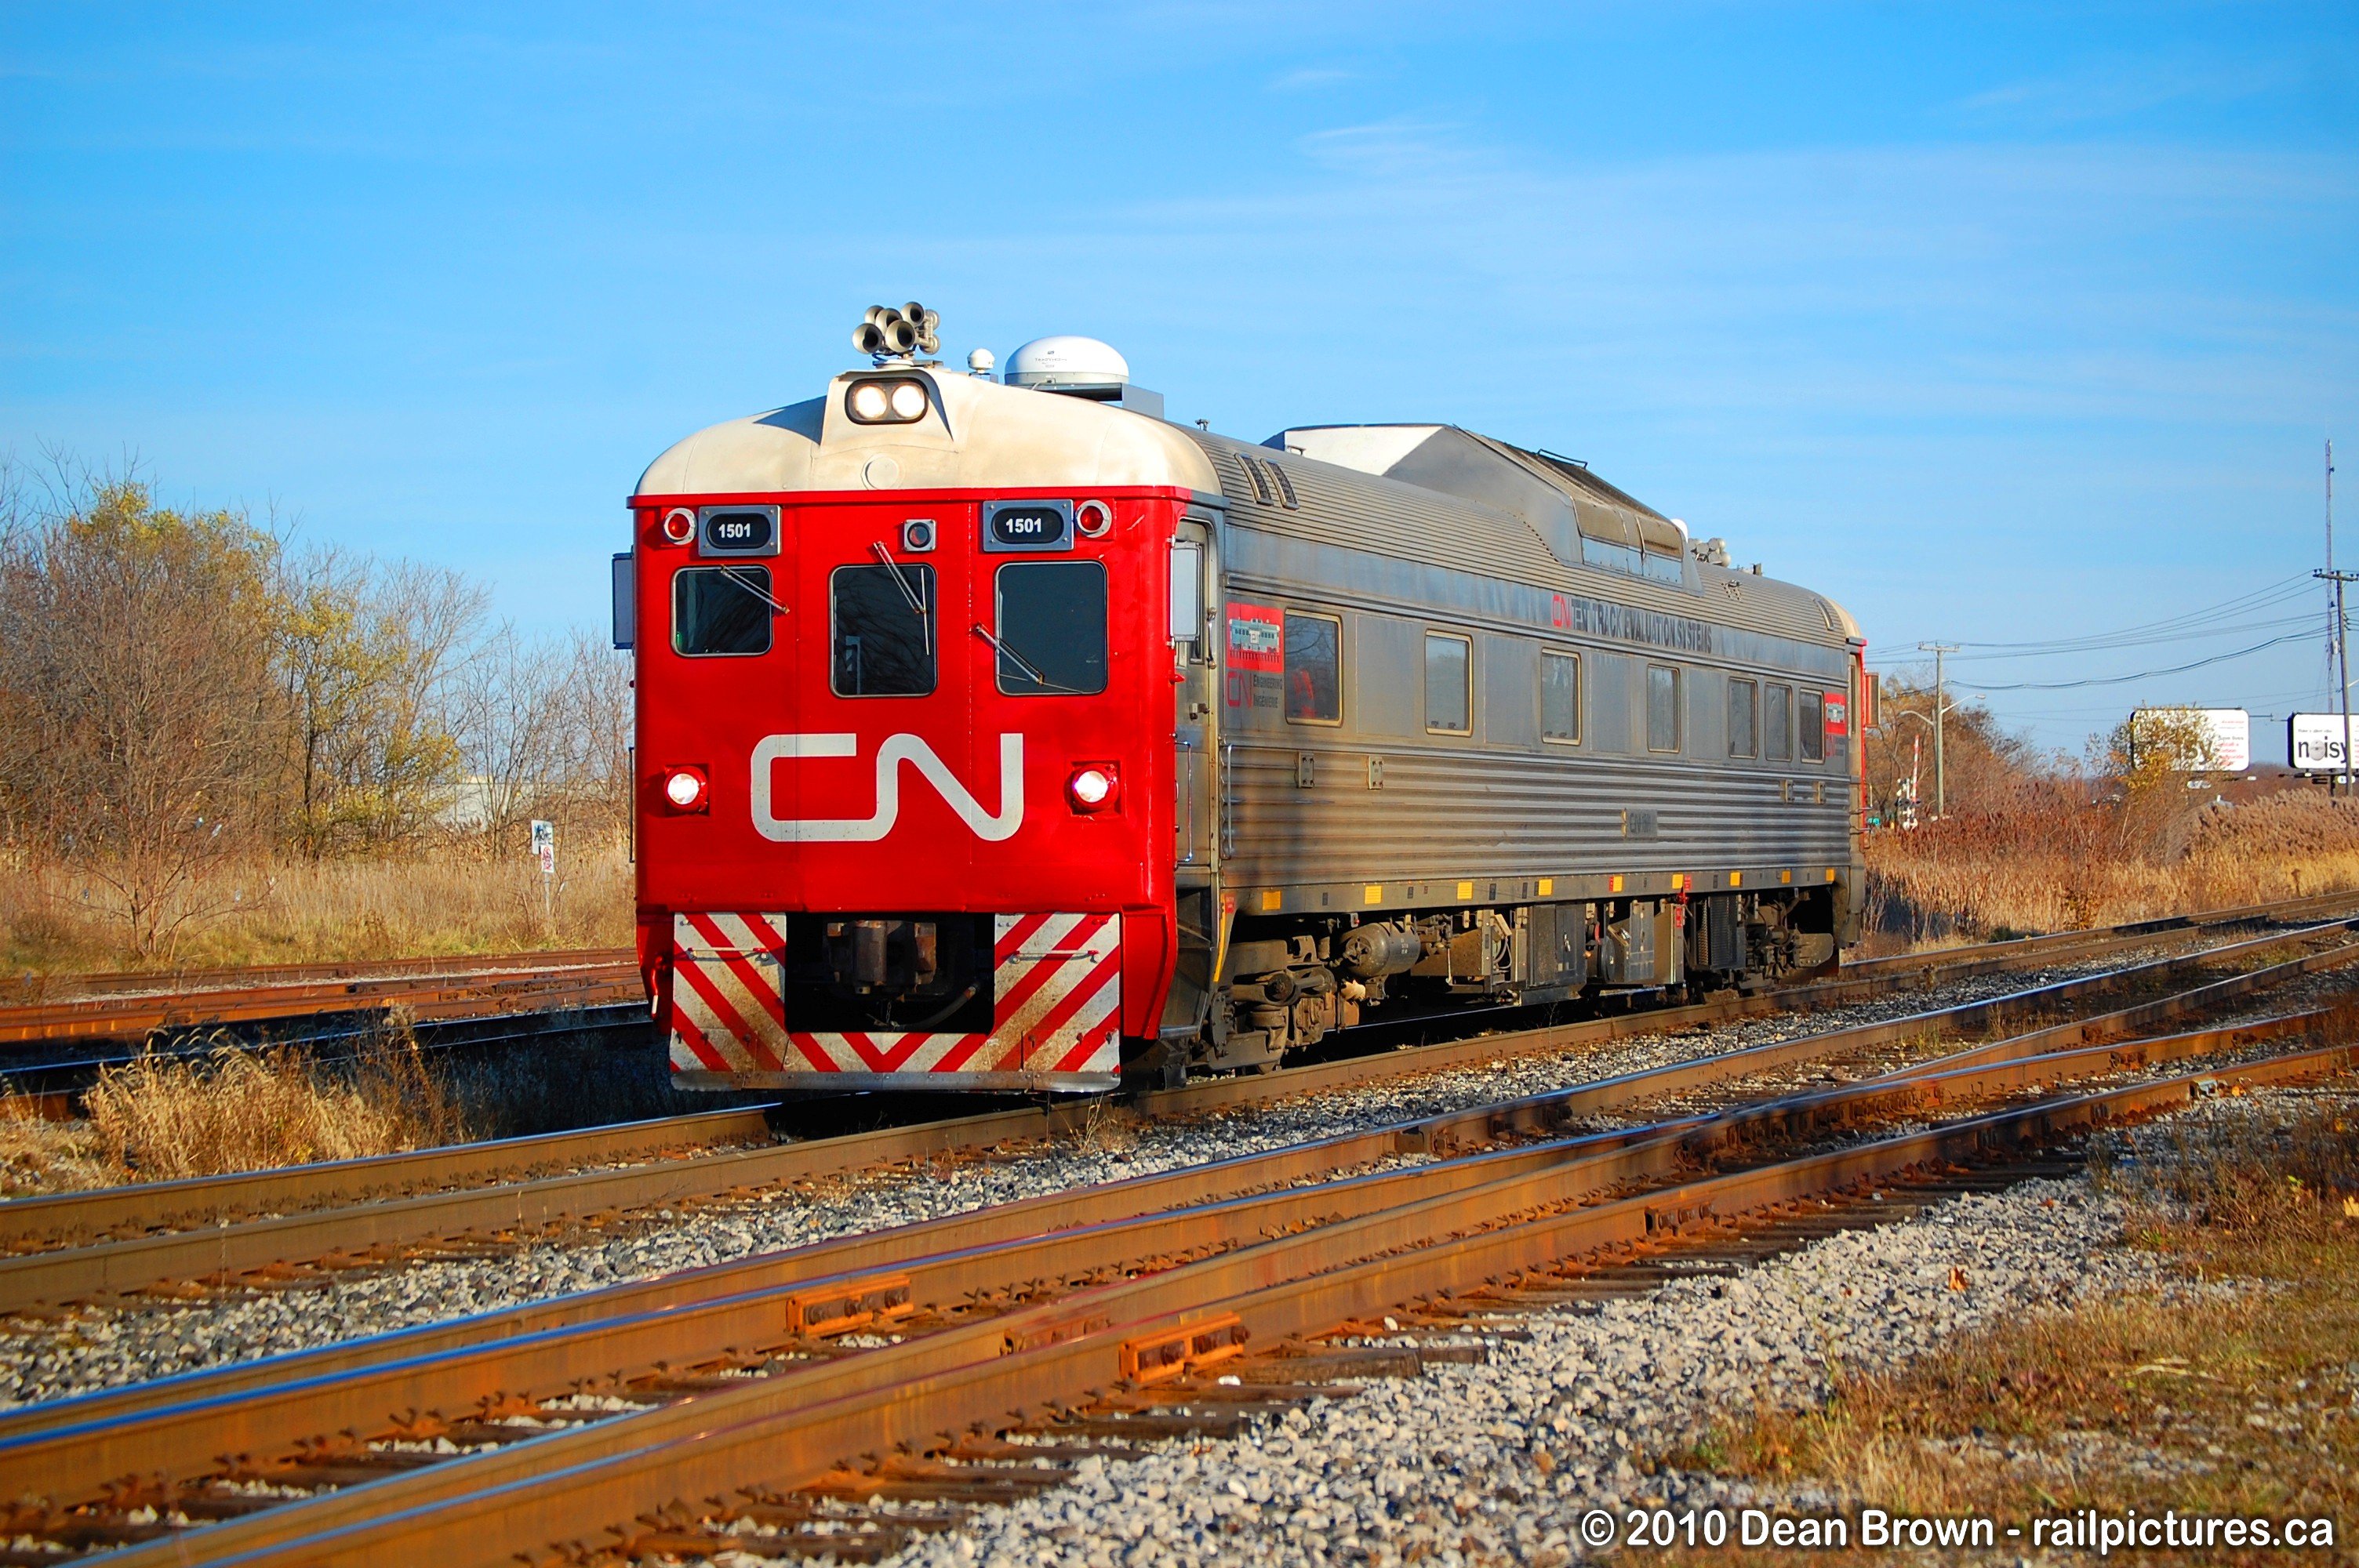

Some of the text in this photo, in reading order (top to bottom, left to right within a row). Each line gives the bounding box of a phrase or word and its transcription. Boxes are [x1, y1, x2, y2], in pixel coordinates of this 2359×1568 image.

[718, 521, 751, 539] 1501
[1005, 517, 1042, 534] 1501
[1552, 593, 1571, 628] CN
[1593, 603, 1623, 638] TRACK
[1624, 609, 1676, 648] EVALUATION
[1677, 619, 1712, 654] SYSTEMS
[1227, 671, 1252, 707] CN
[751, 733, 1024, 842] CN
